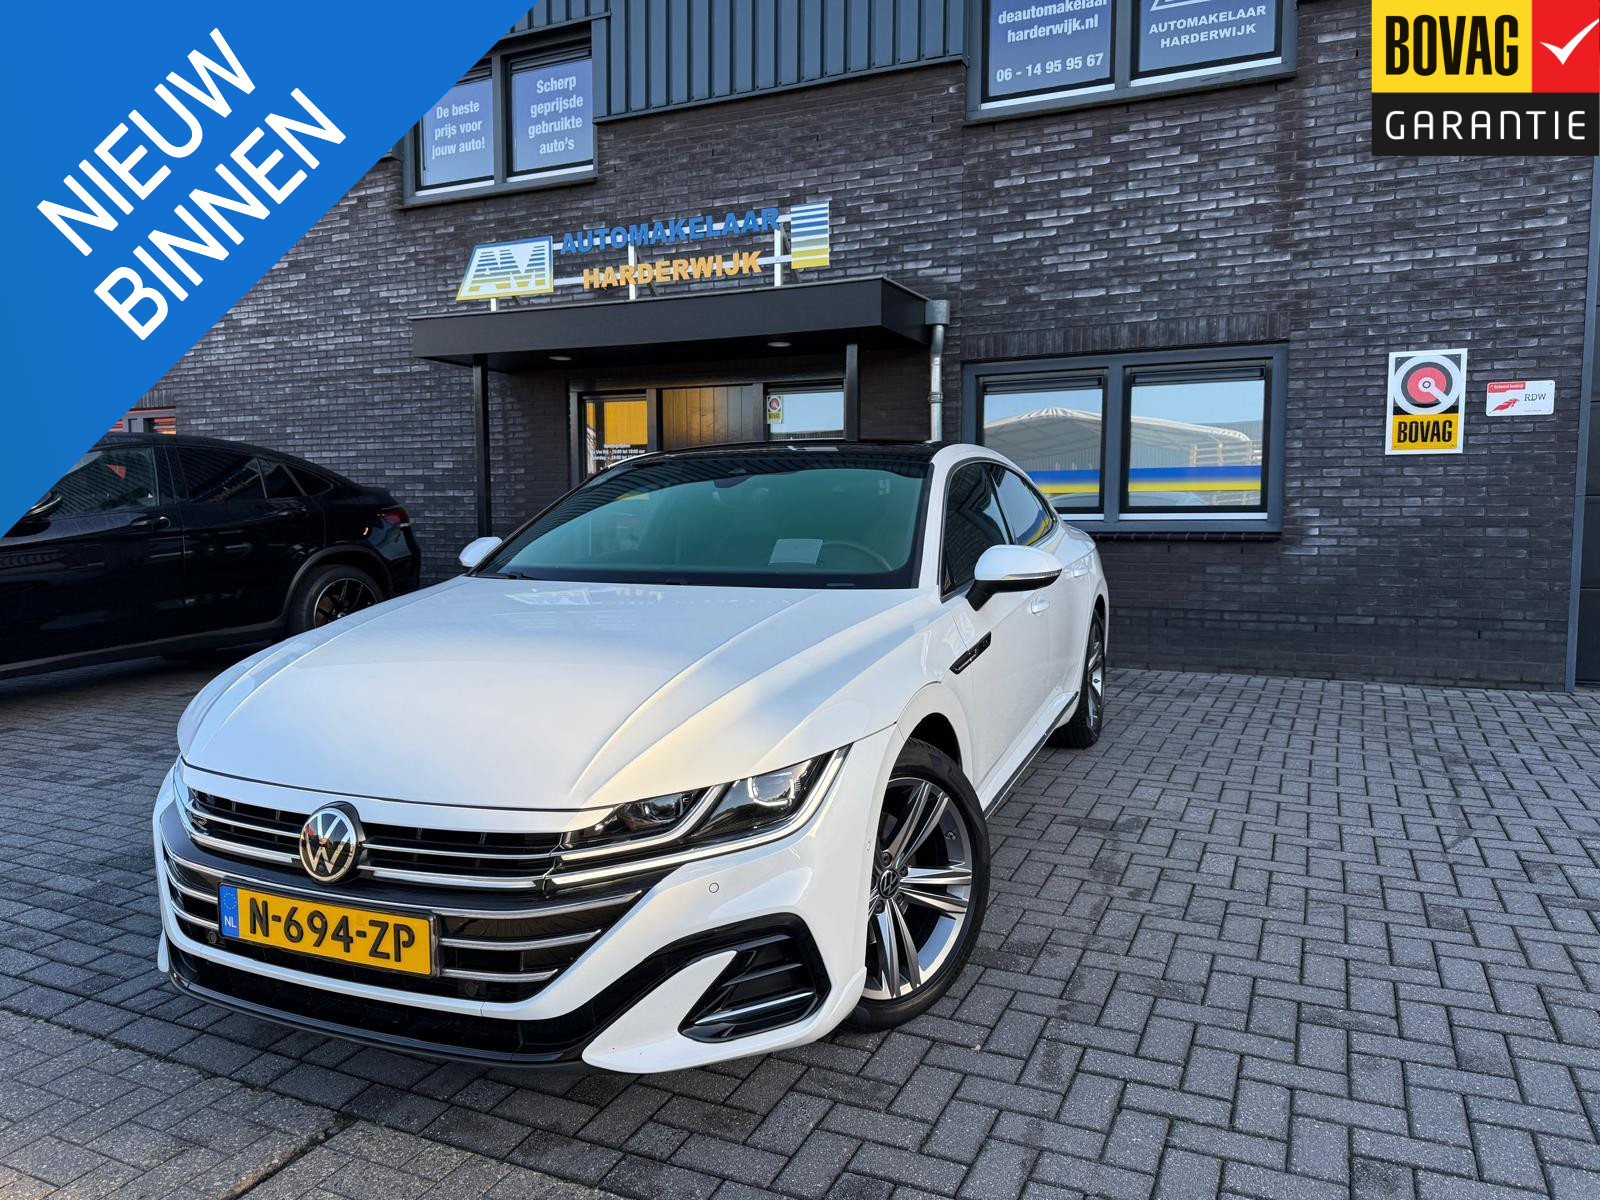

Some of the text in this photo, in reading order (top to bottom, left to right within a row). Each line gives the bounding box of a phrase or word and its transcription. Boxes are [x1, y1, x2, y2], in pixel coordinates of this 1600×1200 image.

[1007, 14, 1099, 43] harderwijk.nl
[1149, 5, 1267, 35] AUTOMAKELAAR
[1160, 23, 1257, 49] HARDERWIJK
[996, 68, 1013, 82] 06
[1025, 63, 1042, 77] 14
[1045, 59, 1062, 74] 95
[1066, 56, 1082, 70] 95
[1086, 52, 1104, 67] 67
[536, 76, 577, 94] Scherp
[436, 101, 480, 119] De beste
[530, 94, 584, 118] geprijsde
[434, 120, 483, 141] prijs voor
[528, 116, 583, 139] gebruikte
[431, 136, 486, 160] jouw auto!
[539, 137, 575, 155] auto's
[560, 207, 781, 255] AUTOMAKELAAR
[582, 250, 763, 290] HARDERWIJK
[1524, 393, 1547, 402] RDW
[1397, 420, 1453, 443] BOVAG
[224, 914, 237, 928] NL
[249, 897, 416, 962] N-694-ZP
